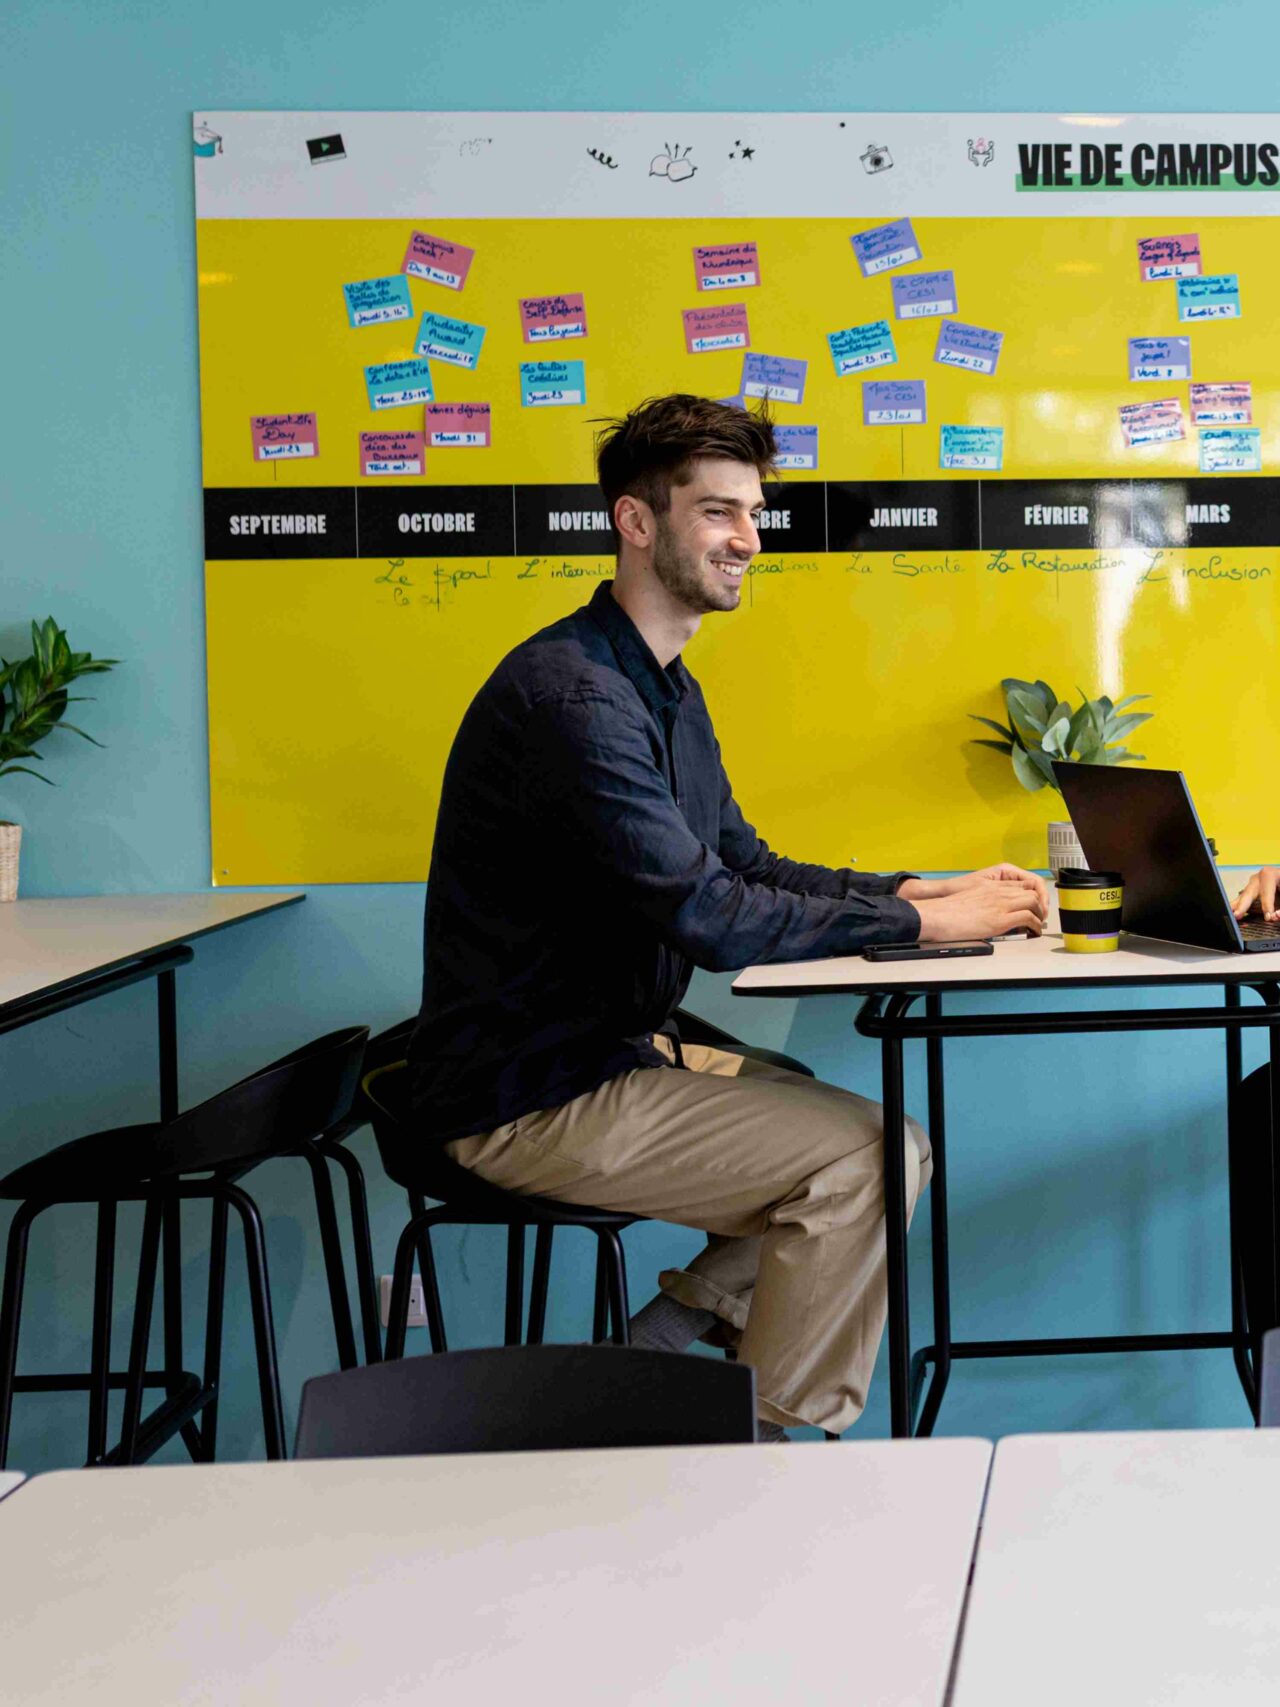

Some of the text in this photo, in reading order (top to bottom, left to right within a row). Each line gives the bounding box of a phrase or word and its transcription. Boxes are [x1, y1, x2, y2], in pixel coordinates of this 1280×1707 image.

[1018, 142, 1280, 187] VIE DE CAMPUS
[230, 514, 327, 535] SEPTEMBRE
[398, 512, 476, 533] OCTOBRE
[548, 511, 612, 531] NOVEM
[870, 508, 938, 527] JANVIER
[1024, 504, 1089, 525] FÉVRIER
[1185, 504, 1231, 524] MARS
[845, 553, 965, 576] La Santé
[986, 550, 1015, 573] La
[375, 559, 413, 586] Le
